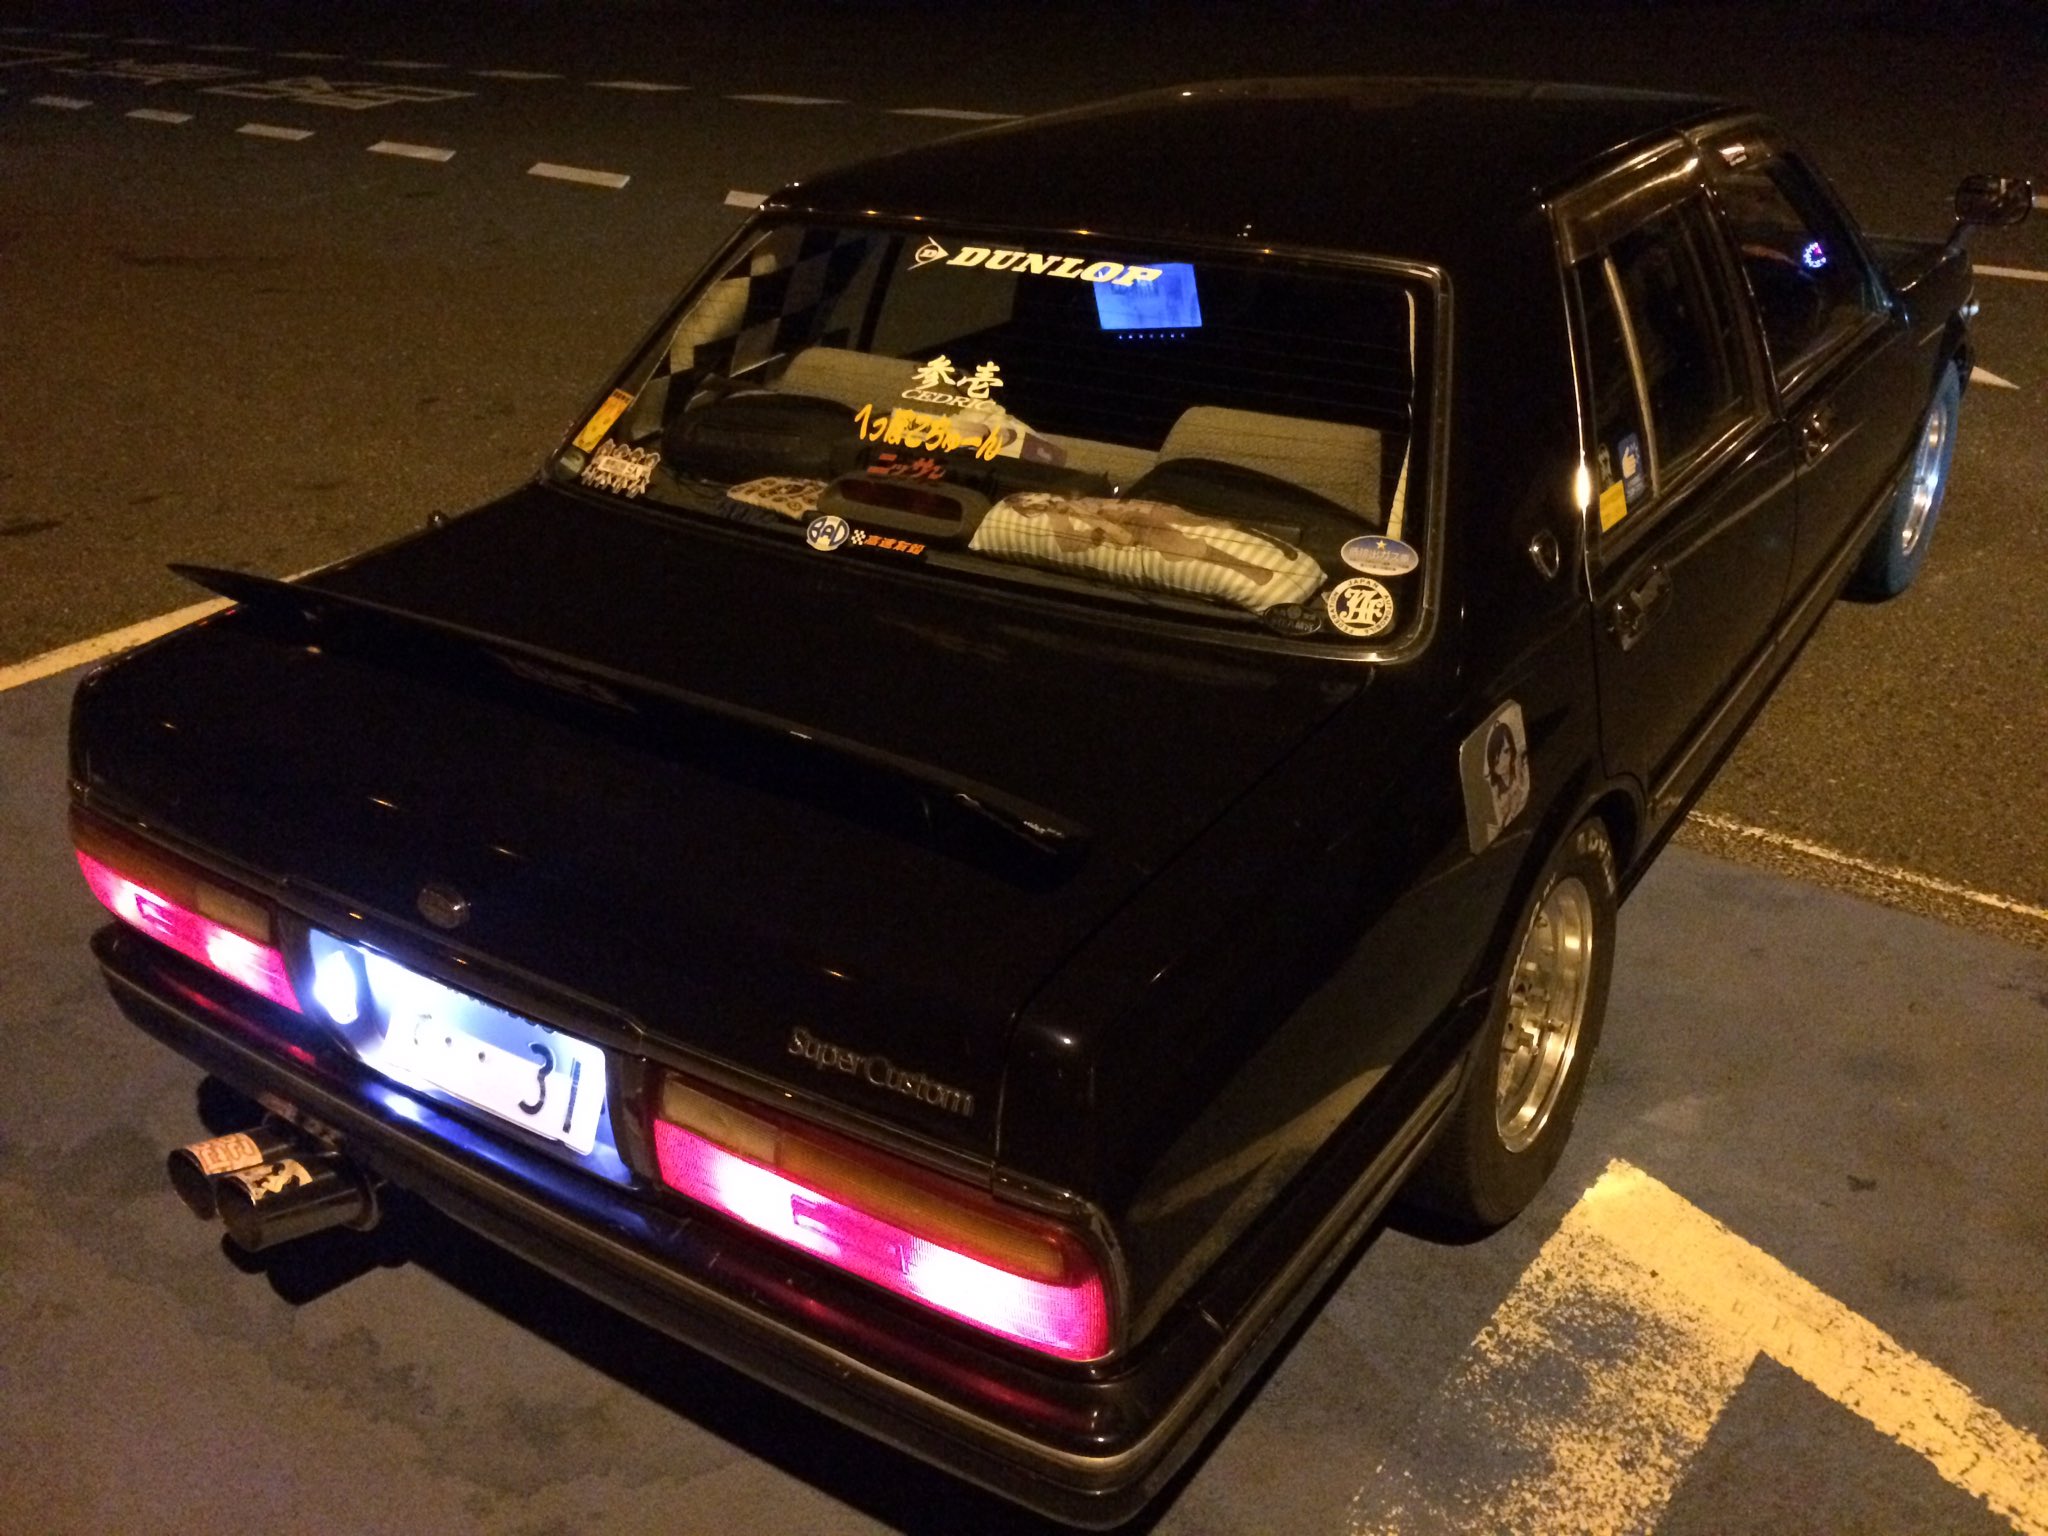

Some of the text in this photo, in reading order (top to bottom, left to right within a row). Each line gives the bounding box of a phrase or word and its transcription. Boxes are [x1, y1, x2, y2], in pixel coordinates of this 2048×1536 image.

[946, 247, 1162, 287] DUNLOP
[901, 388, 997, 411] CEDRIC
[1347, 578, 1378, 588] JAPAN
